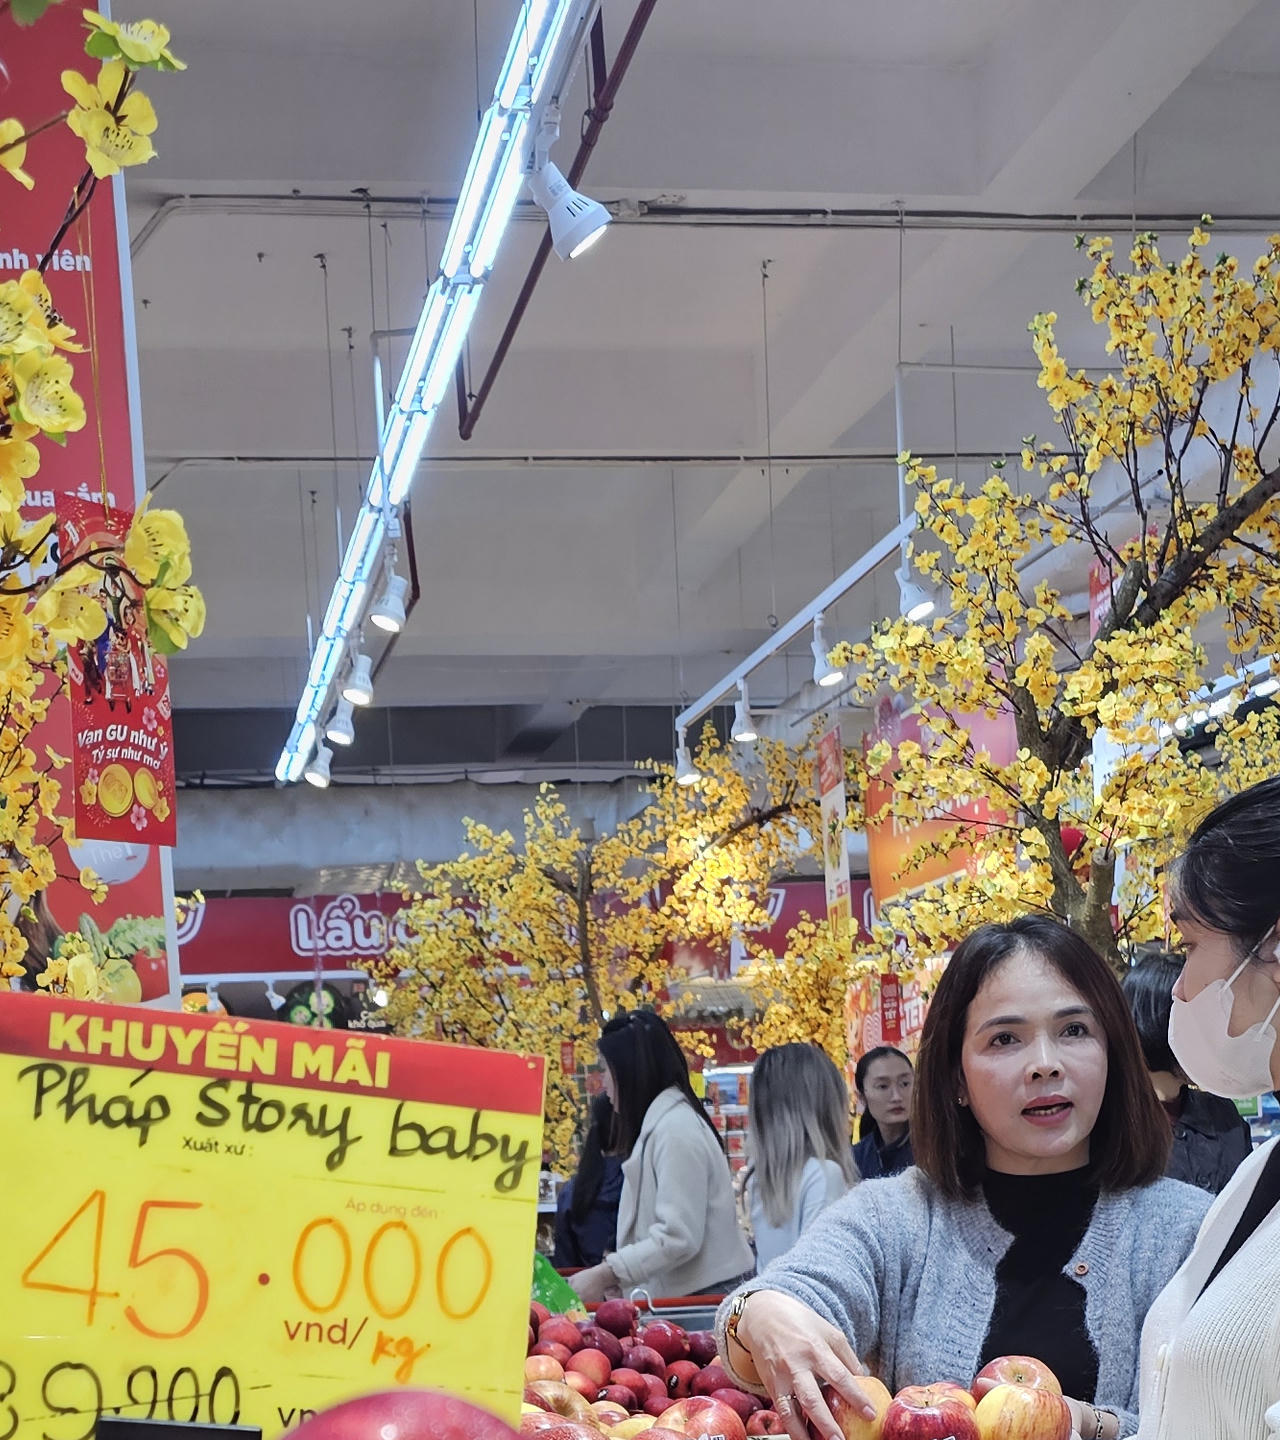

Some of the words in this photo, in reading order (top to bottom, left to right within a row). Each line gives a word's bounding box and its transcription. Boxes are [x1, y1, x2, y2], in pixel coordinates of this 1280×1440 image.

[76, 728, 103, 750] Vạn
[105, 724, 129, 742] GU
[129, 729, 158, 752] như
[158, 742, 169, 761] ý
[120, 747, 142, 763] như
[293, 897, 386, 953] Lẩu
[47, 1010, 277, 1077] KHUYẾN
[291, 1034, 391, 1090] MÃI
[17, 1060, 170, 1147] Pháp
[194, 1076, 363, 1172] Story
[387, 1098, 540, 1194] baby
[181, 1135, 220, 1157] Xuất
[20, 1188, 494, 1340] 45.000
